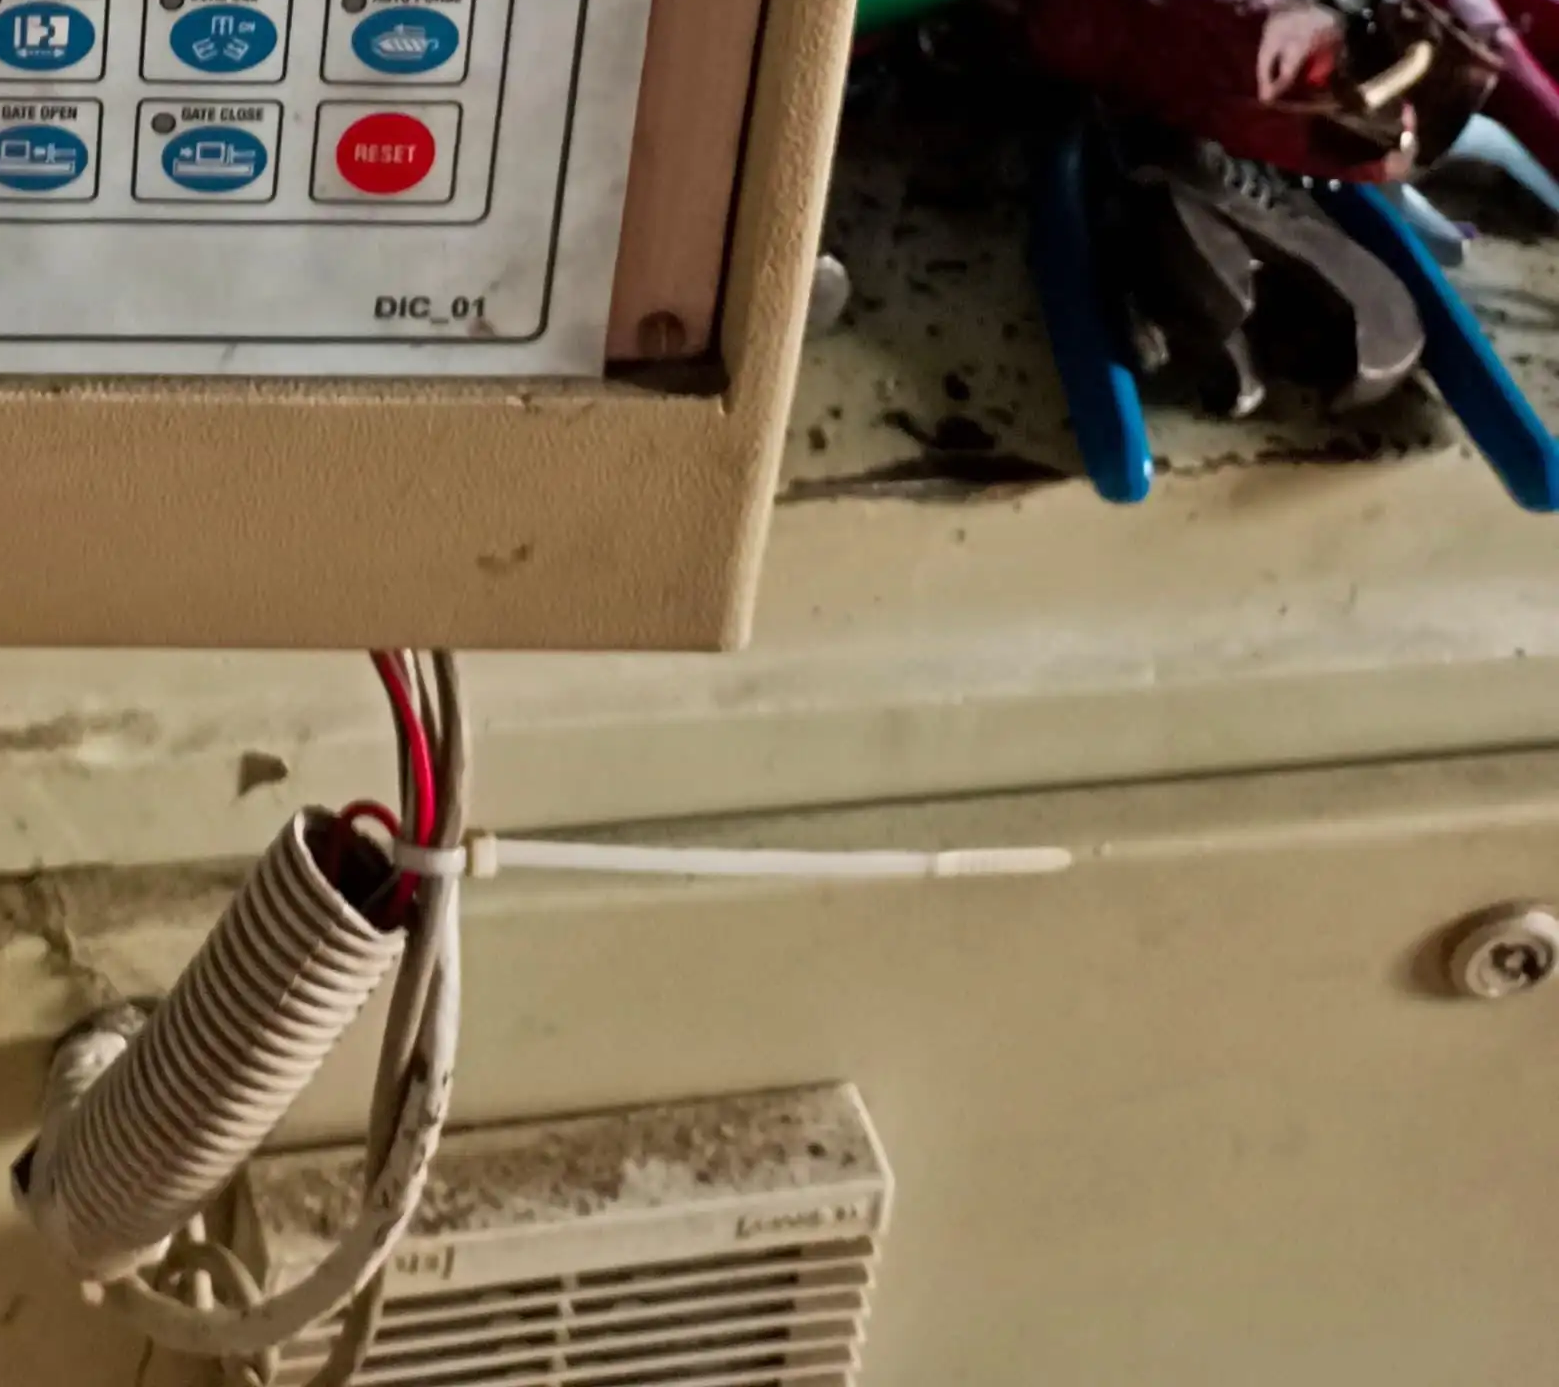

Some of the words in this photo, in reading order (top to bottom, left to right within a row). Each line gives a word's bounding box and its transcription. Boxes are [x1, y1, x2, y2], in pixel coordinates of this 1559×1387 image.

[1, 105, 35, 120] GATE
[40, 105, 78, 121] OPEN
[181, 107, 215, 122] GATE
[220, 107, 263, 122] CLOSE
[354, 143, 416, 163] RESET
